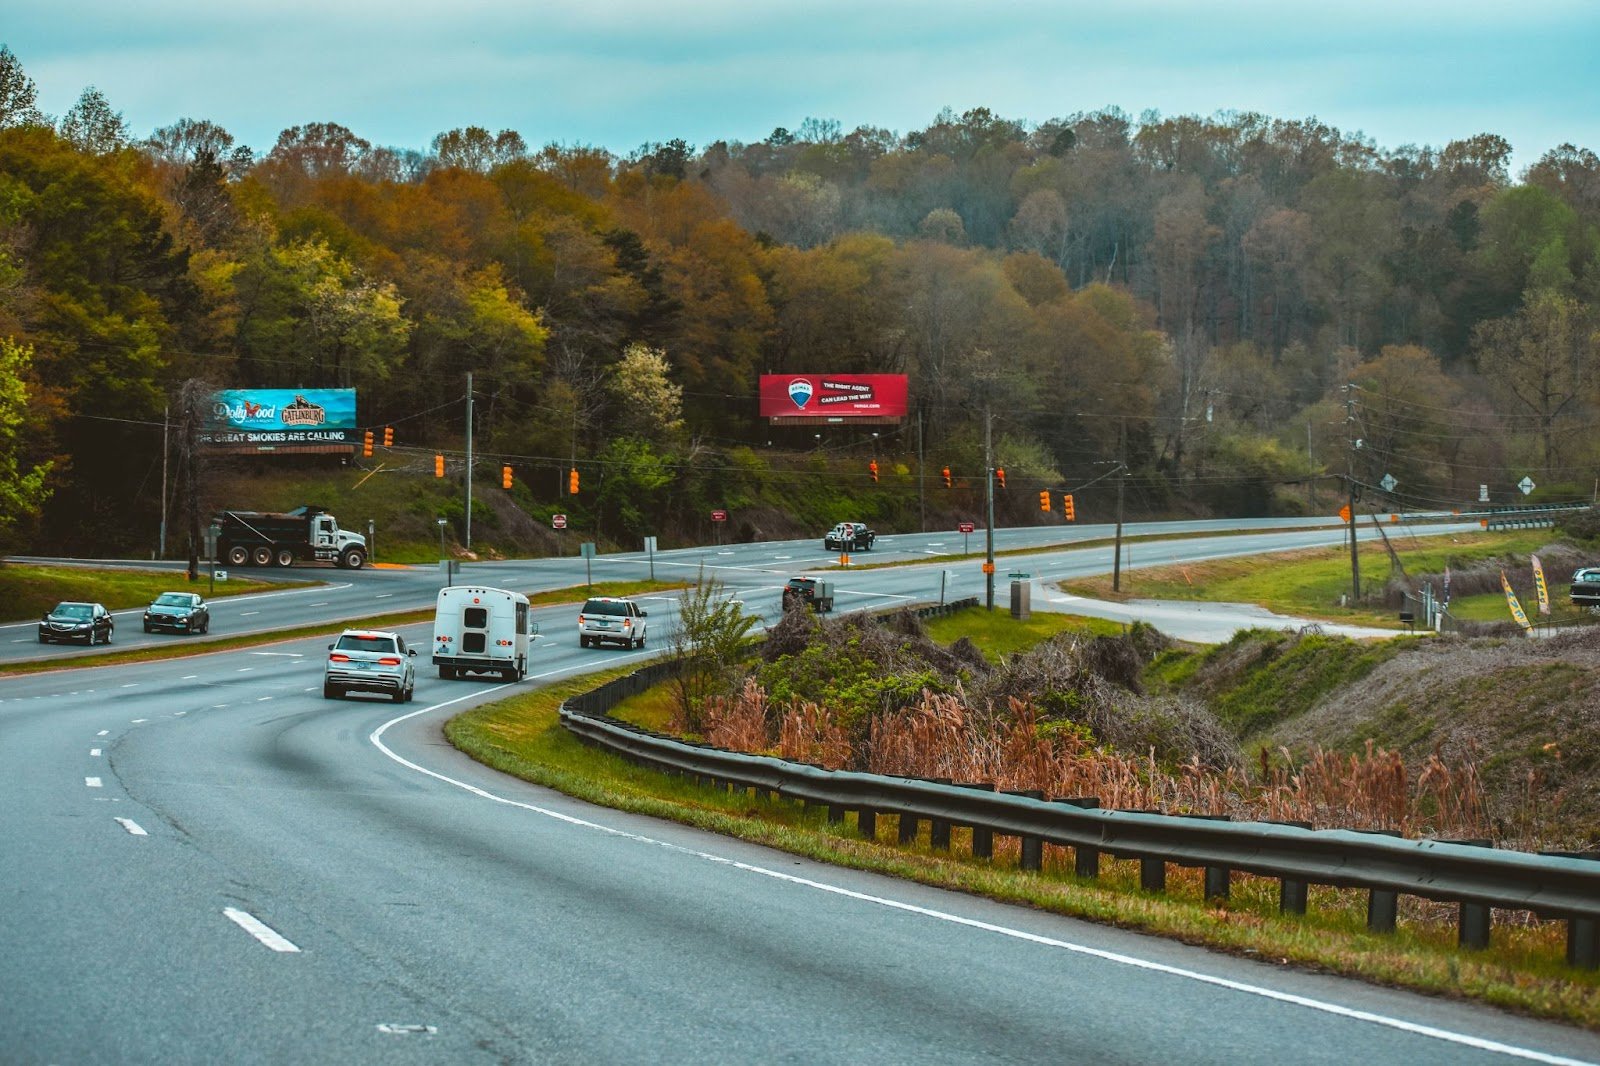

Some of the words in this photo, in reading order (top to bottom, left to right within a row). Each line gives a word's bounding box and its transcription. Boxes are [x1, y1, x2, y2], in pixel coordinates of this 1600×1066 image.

[247, 432, 286, 442] SMOKIES
[288, 432, 306, 441] ARE
[307, 431, 345, 440] CALLING
